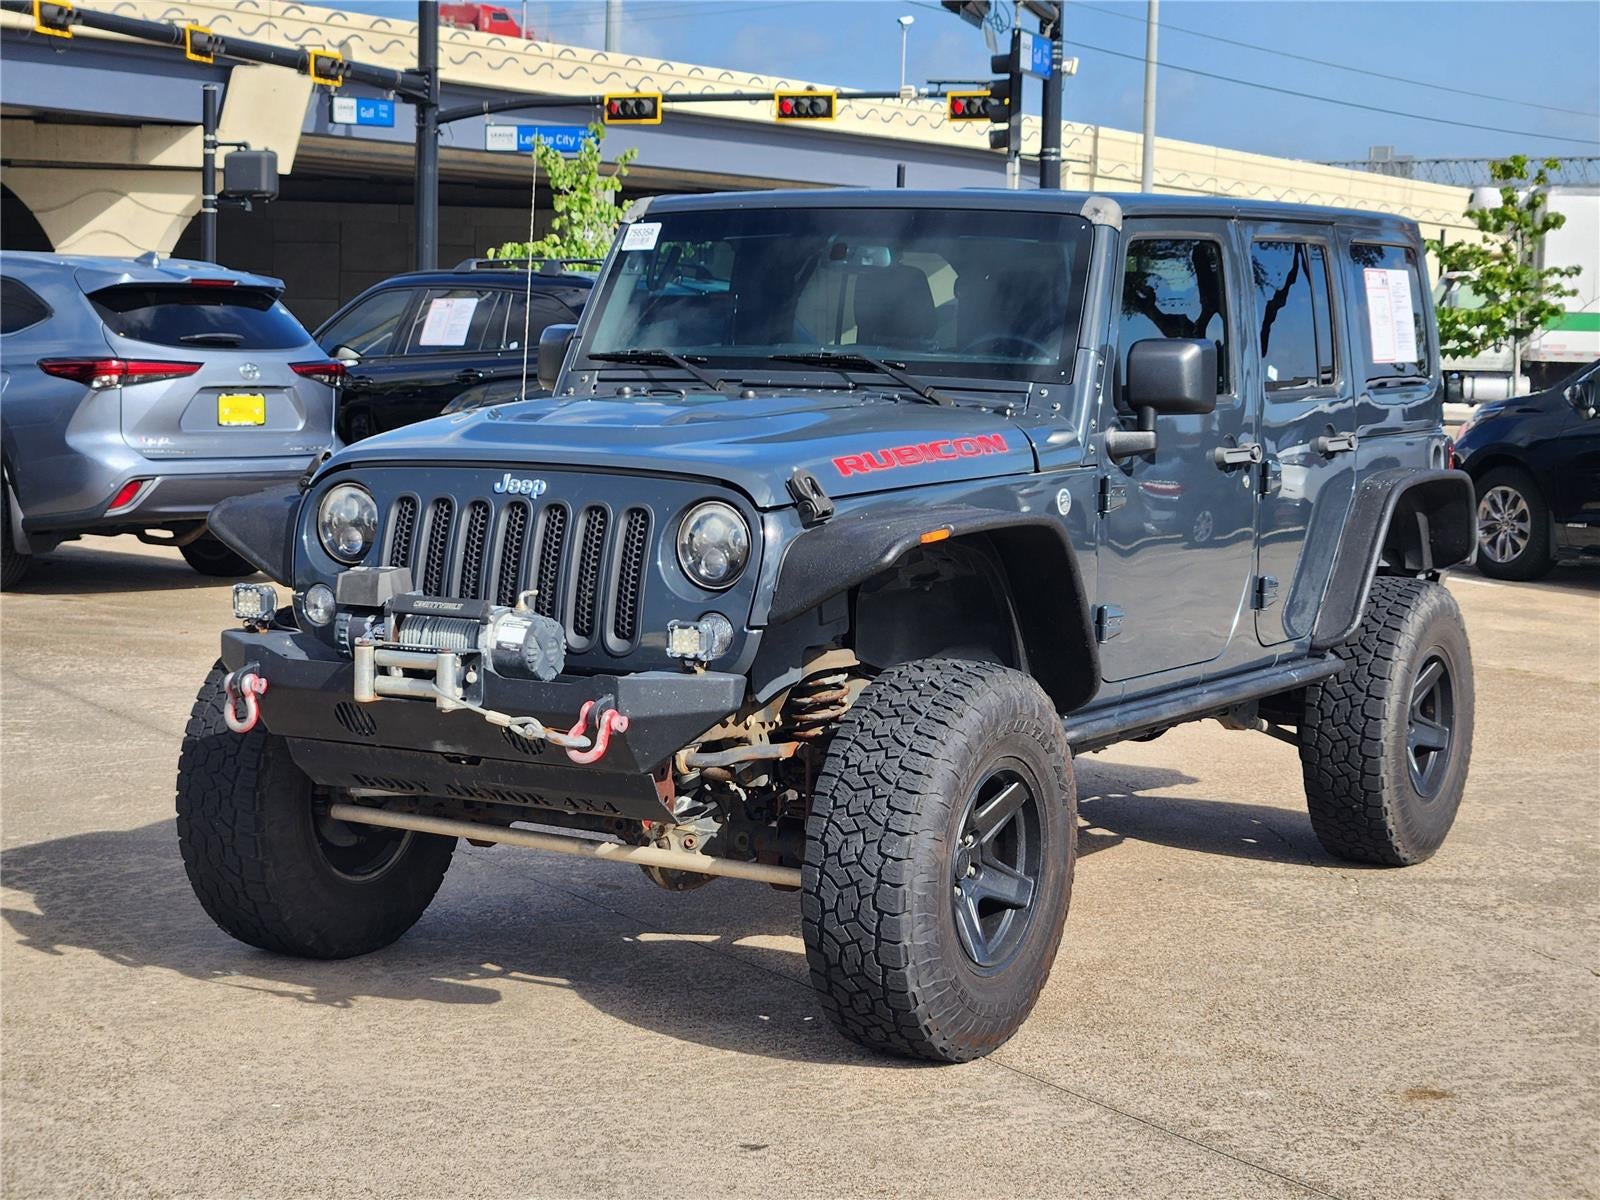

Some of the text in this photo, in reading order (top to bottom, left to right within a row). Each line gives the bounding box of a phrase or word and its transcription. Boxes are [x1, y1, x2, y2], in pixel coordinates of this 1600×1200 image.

[360, 106, 375, 119] Gulf
[519, 133, 555, 146] Leue
[556, 134, 576, 148] City
[832, 433, 1009, 477] RUBICON
[493, 473, 547, 499] Jeep
